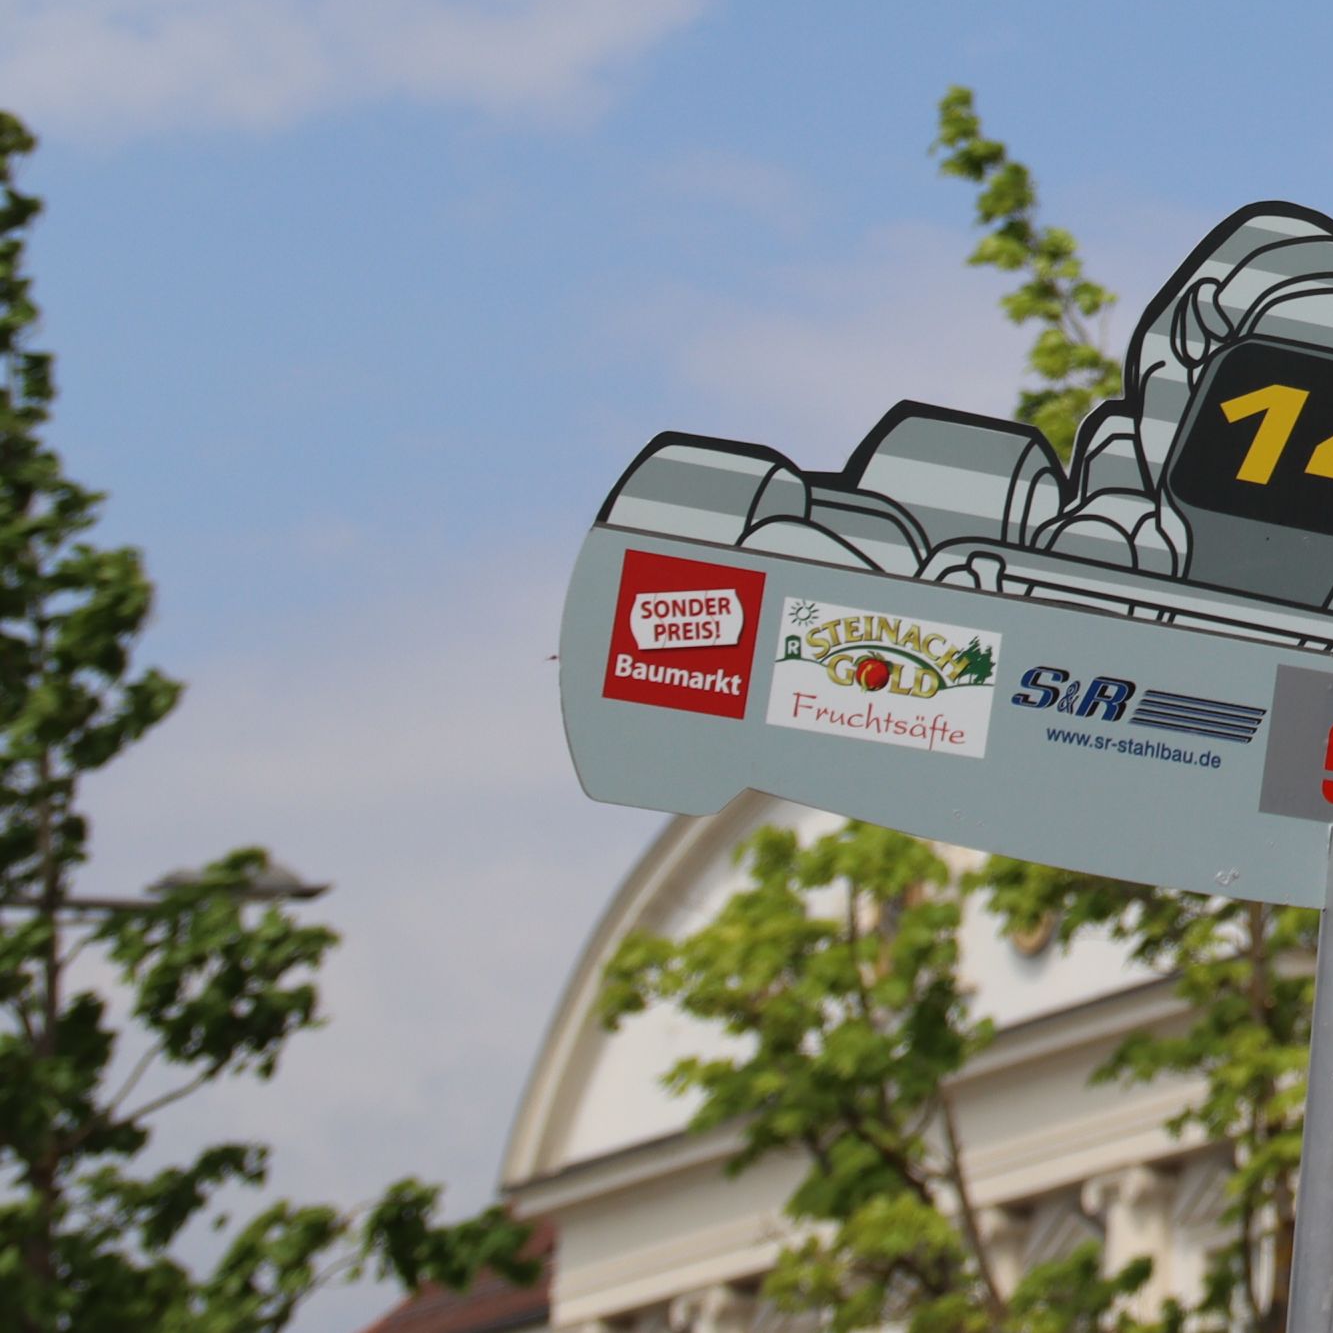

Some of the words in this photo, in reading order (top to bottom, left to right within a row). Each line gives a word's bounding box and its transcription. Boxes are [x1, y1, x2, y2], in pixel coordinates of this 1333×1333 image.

[640, 596, 732, 620] SONDER
[653, 617, 722, 642] PREIS!
[805, 615, 971, 683] STEINACH
[613, 653, 742, 697] Baumarkt
[1011, 666, 1137, 722] S&R
[792, 692, 966, 751] Fruchtsäfte
[1045, 727, 1222, 769] www.sr-stahlbau.de
